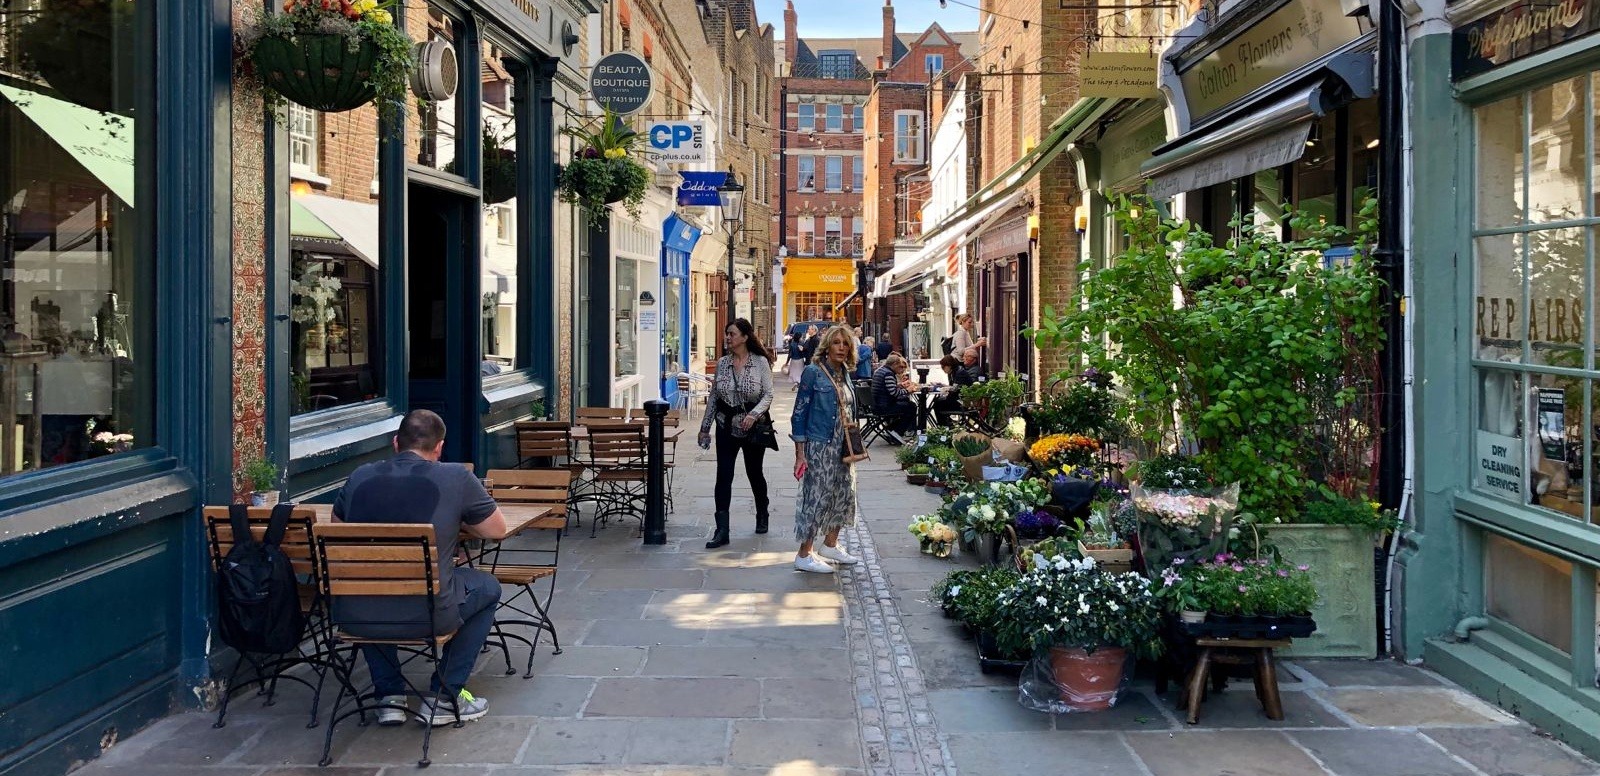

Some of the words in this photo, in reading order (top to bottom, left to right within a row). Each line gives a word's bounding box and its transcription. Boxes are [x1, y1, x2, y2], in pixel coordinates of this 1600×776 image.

[1467, 0, 1585, 59] Professional
[1238, 26, 1293, 76] Flowers
[599, 65, 643, 74] BEAUTY
[593, 78, 650, 88] BOUTIQUE
[1083, 77, 1096, 85] The
[649, 124, 693, 150] CP
[693, 125, 703, 149] PLUS
[650, 153, 701, 161] cp-plus.co.uk
[680, 180, 717, 191] Oddon
[1491, 445, 1507, 458] DRY
[1481, 459, 1521, 478] CLEANING
[1486, 475, 1520, 493] SERVICE
